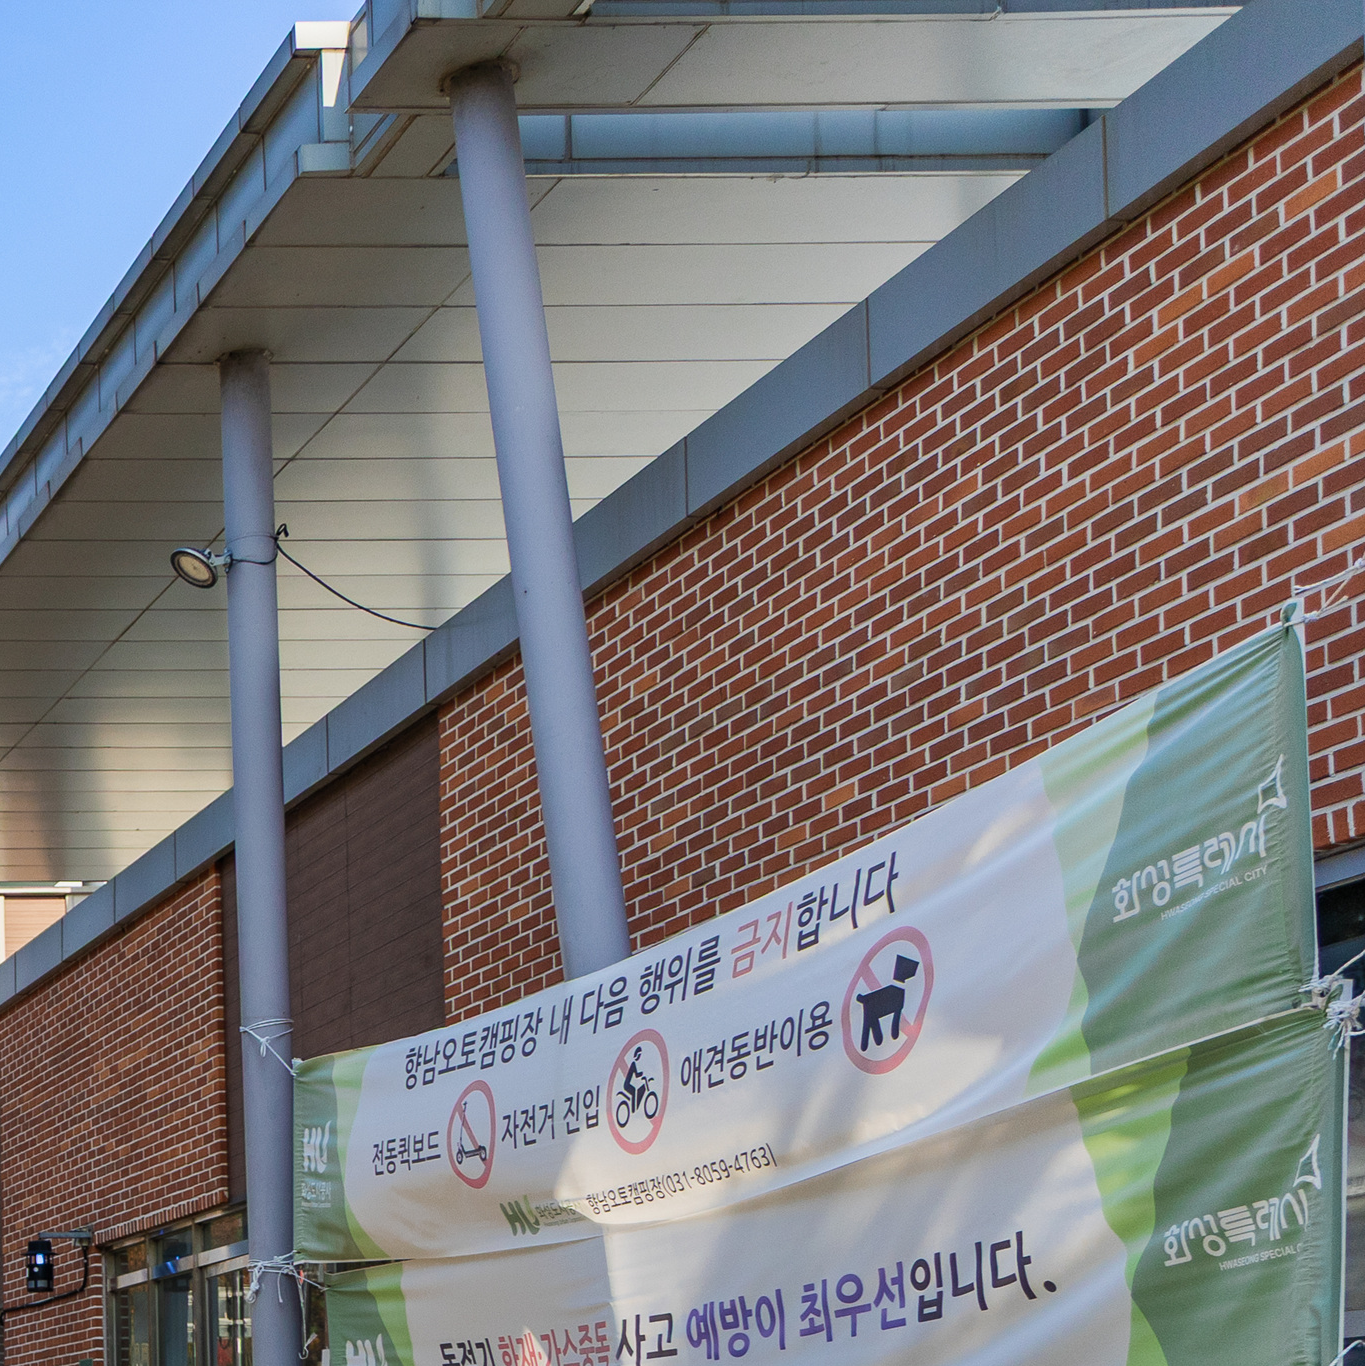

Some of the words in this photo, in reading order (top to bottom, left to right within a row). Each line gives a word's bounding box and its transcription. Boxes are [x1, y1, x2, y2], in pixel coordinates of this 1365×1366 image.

[1203, 876, 1243, 899] SPECIAL
[1244, 865, 1268, 882] CITY
[405, 1006, 544, 1090] 향남오토캠핑장
[548, 994, 574, 1045] 내
[579, 976, 629, 1035] 다음
[639, 935, 721, 1015] 행위를
[730, 851, 900, 980] 금지합니다
[372, 1130, 441, 1176] 전동퀵보드
[501, 1098, 556, 1150] 자전거
[563, 1085, 601, 1135] 진입
[680, 1000, 833, 1094] 애견동반이용
[685, 1288, 787, 1362] 예방이
[798, 1230, 1058, 1343] 최우선입니다.
[1219, 1252, 1260, 1272] HWASEONG
[1259, 1245, 1296, 1263] SPECIAL
